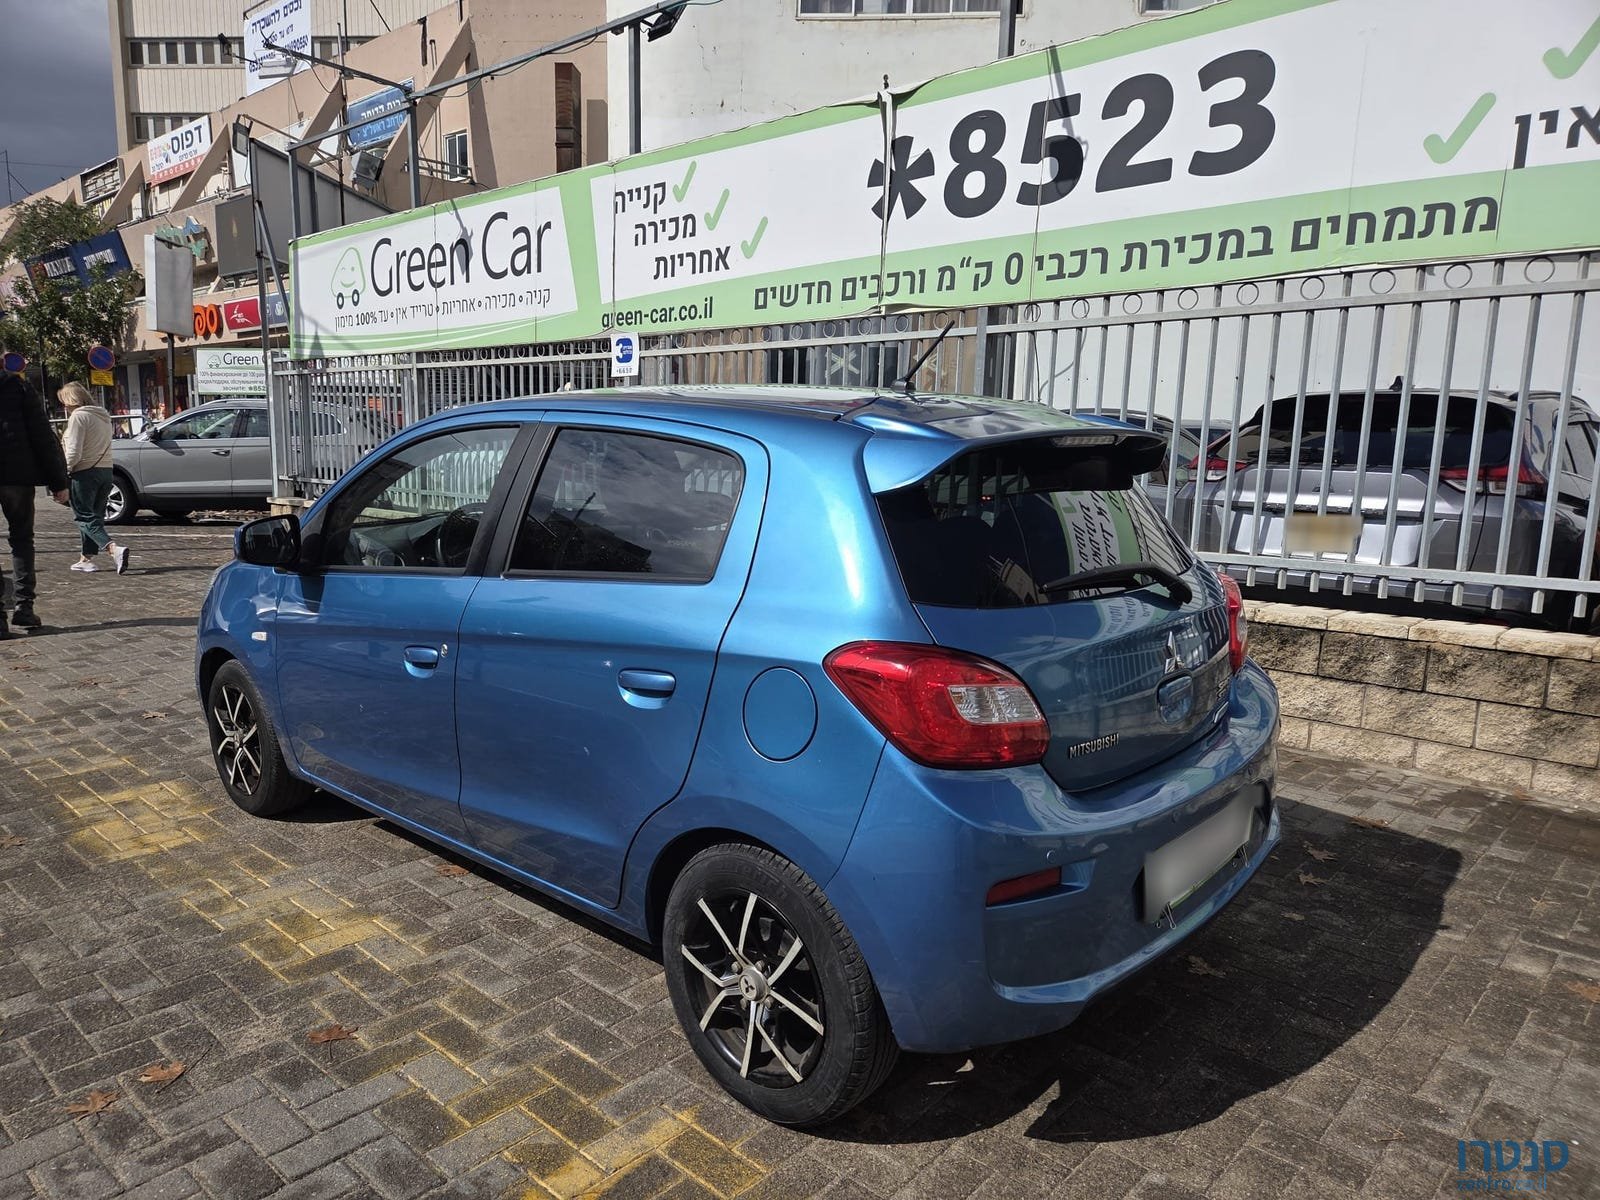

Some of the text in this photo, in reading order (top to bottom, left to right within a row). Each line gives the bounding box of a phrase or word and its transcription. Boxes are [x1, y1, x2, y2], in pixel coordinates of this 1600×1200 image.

[171, 124, 202, 154] דפוס
[1512, 105, 1600, 170] אין
[615, 181, 667, 214] קנייה
[634, 213, 697, 247] מכירה
[370, 211, 552, 297] Green Car
[653, 246, 731, 280] אחריות
[754, 196, 1499, 310] מתמחים במכירת רכבי 0 ק"מ ורכבים חדשים
[335, 288, 551, 333] קניה מכירה אחריות טרייד אין עד 100% מימון
[601, 296, 714, 331] green-car.co.il
[223, 352, 259, 365] Green
[1068, 733, 1119, 759] MITSUBISHI
